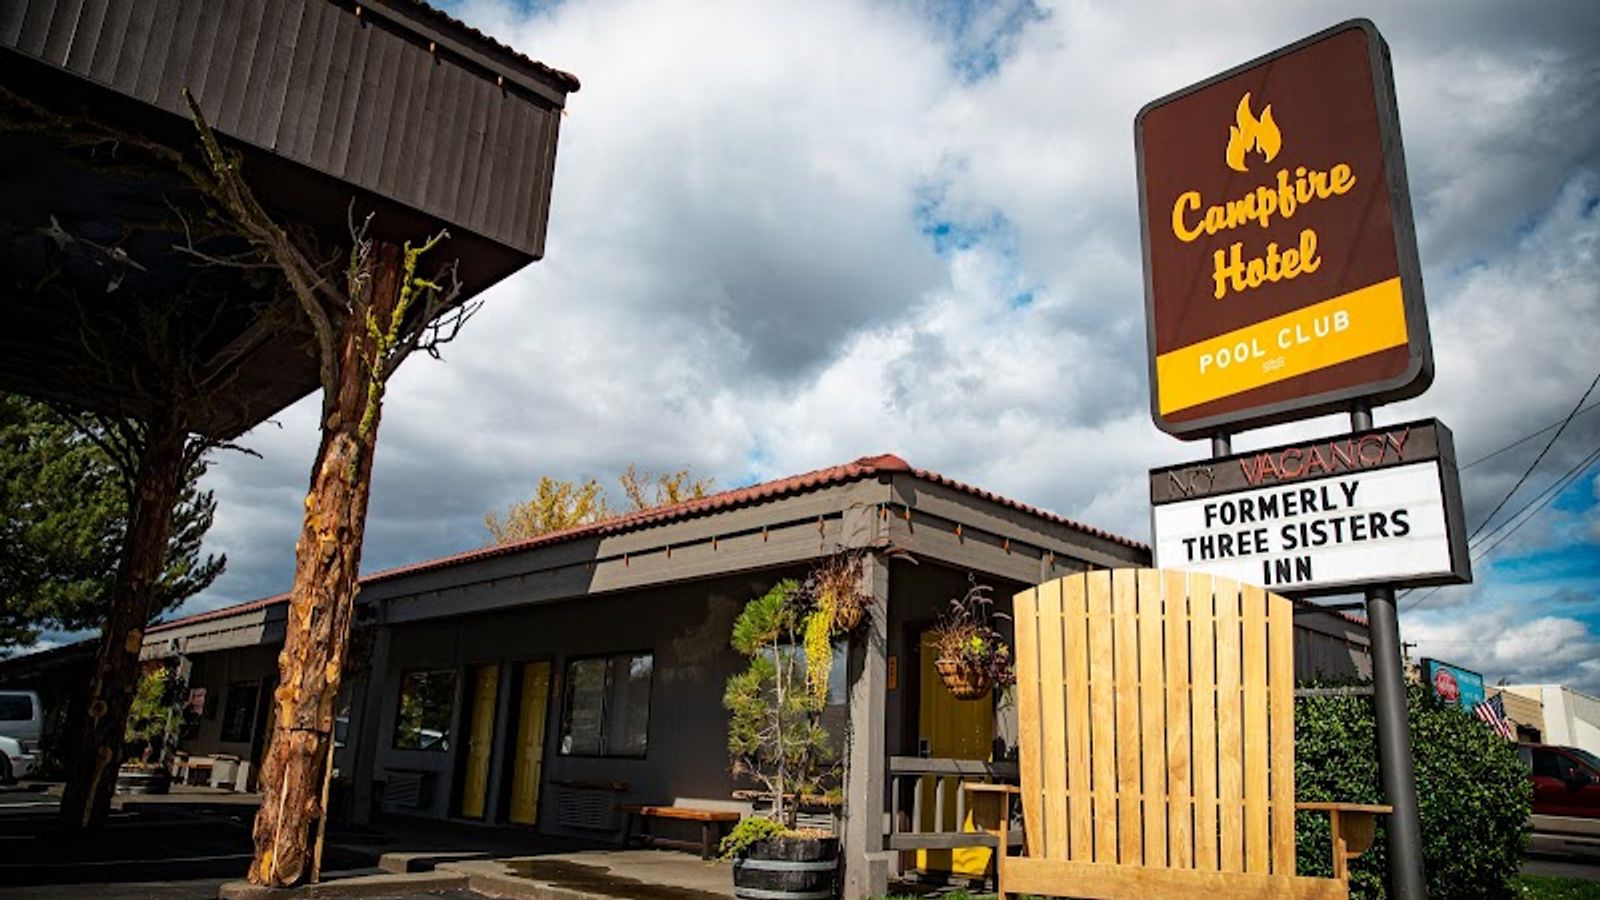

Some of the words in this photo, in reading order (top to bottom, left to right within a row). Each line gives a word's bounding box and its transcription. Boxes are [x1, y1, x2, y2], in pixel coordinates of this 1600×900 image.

[1173, 164, 1355, 242] Campfire
[1213, 229, 1321, 298] Hotel
[1200, 339, 1265, 373] POOL
[1278, 310, 1349, 349] CLUB
[1240, 429, 1409, 483] VACANCY
[1204, 481, 1360, 528] FORMERLY
[1182, 528, 1269, 562] THREE
[1282, 510, 1410, 550] SISTERS
[1263, 556, 1313, 585] INN
